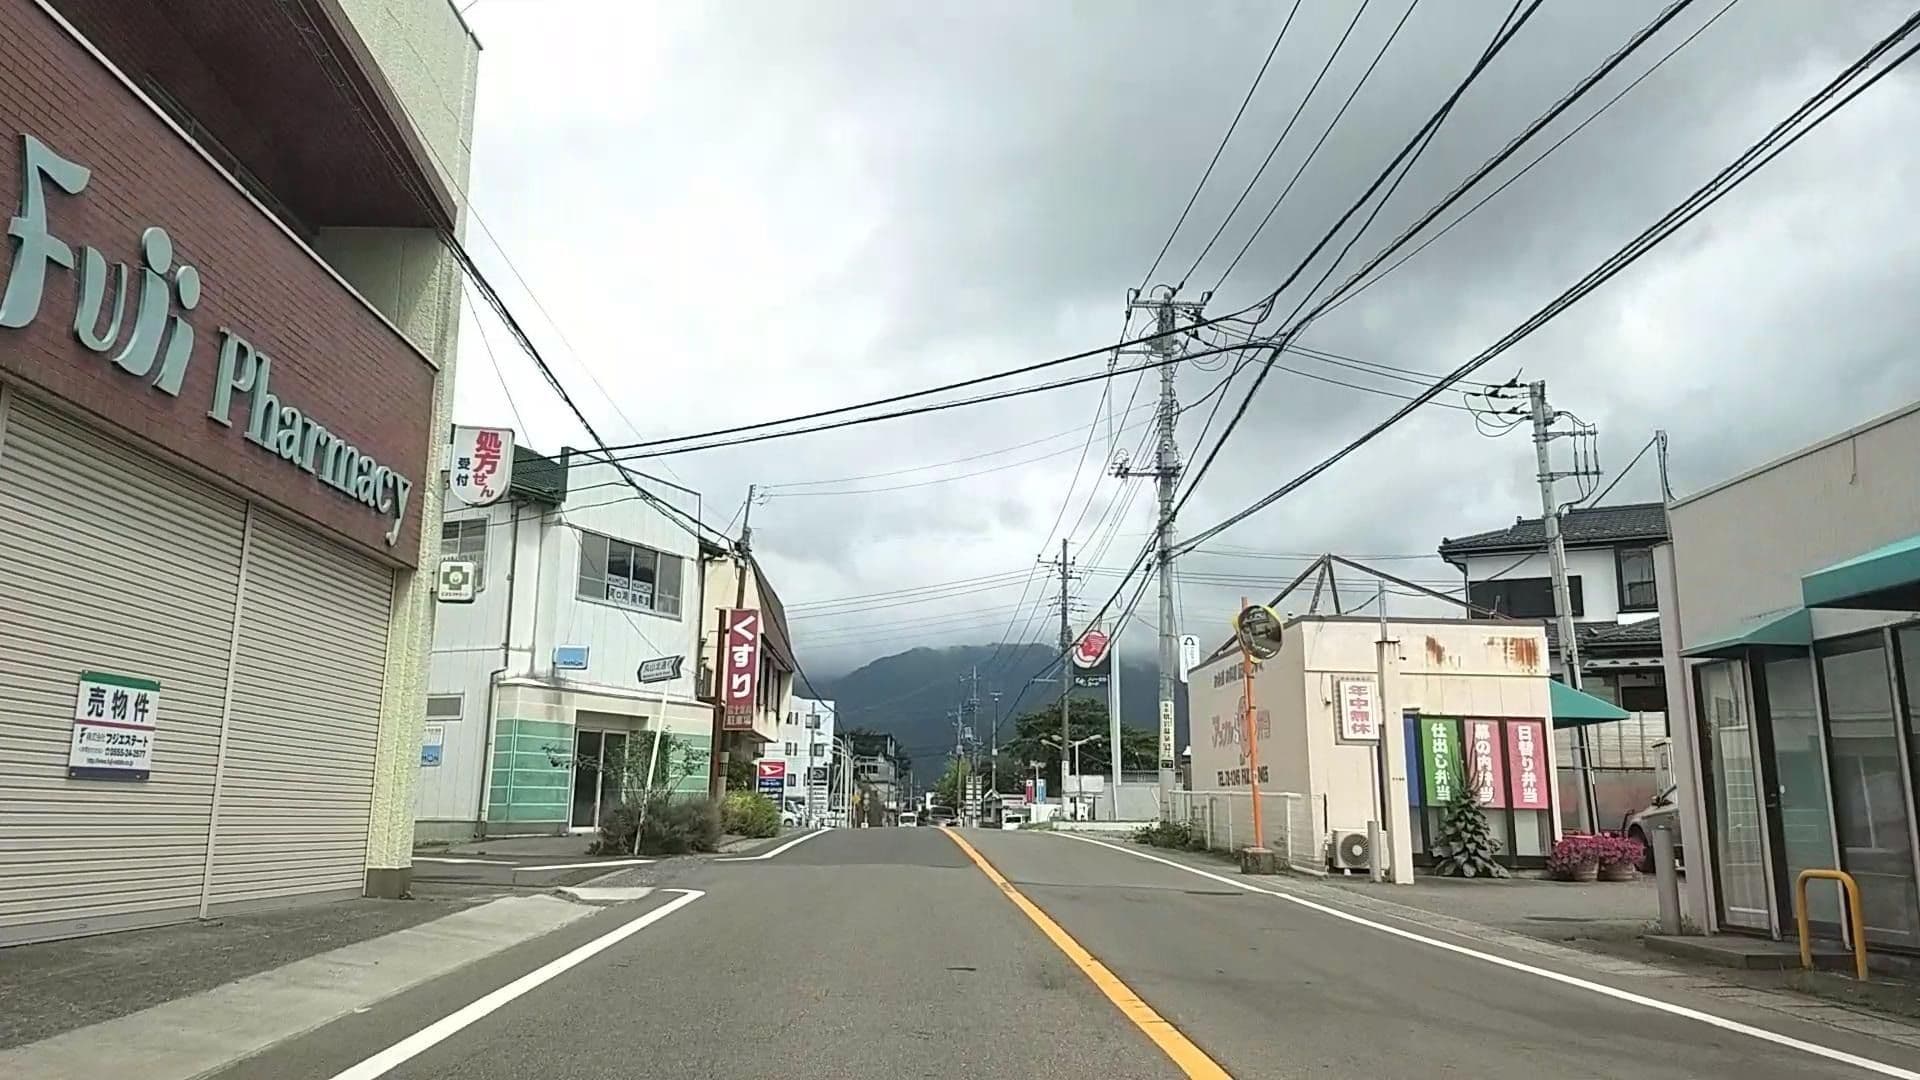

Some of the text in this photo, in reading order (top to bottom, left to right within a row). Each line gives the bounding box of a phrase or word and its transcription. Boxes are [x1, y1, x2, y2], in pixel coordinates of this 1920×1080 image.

[0, 132, 413, 547] Fuji Pharmacy
[456, 457, 470, 487] 受付
[472, 430, 502, 498] 処方せん
[732, 615, 757, 698] くすり
[87, 686, 150, 723] 売物件
[1348, 684, 1371, 735] 年中無休
[106, 733, 148, 747] フジエステート
[1431, 722, 1452, 802] 仕出し弁当
[1518, 725, 1538, 803] 日替り弁当
